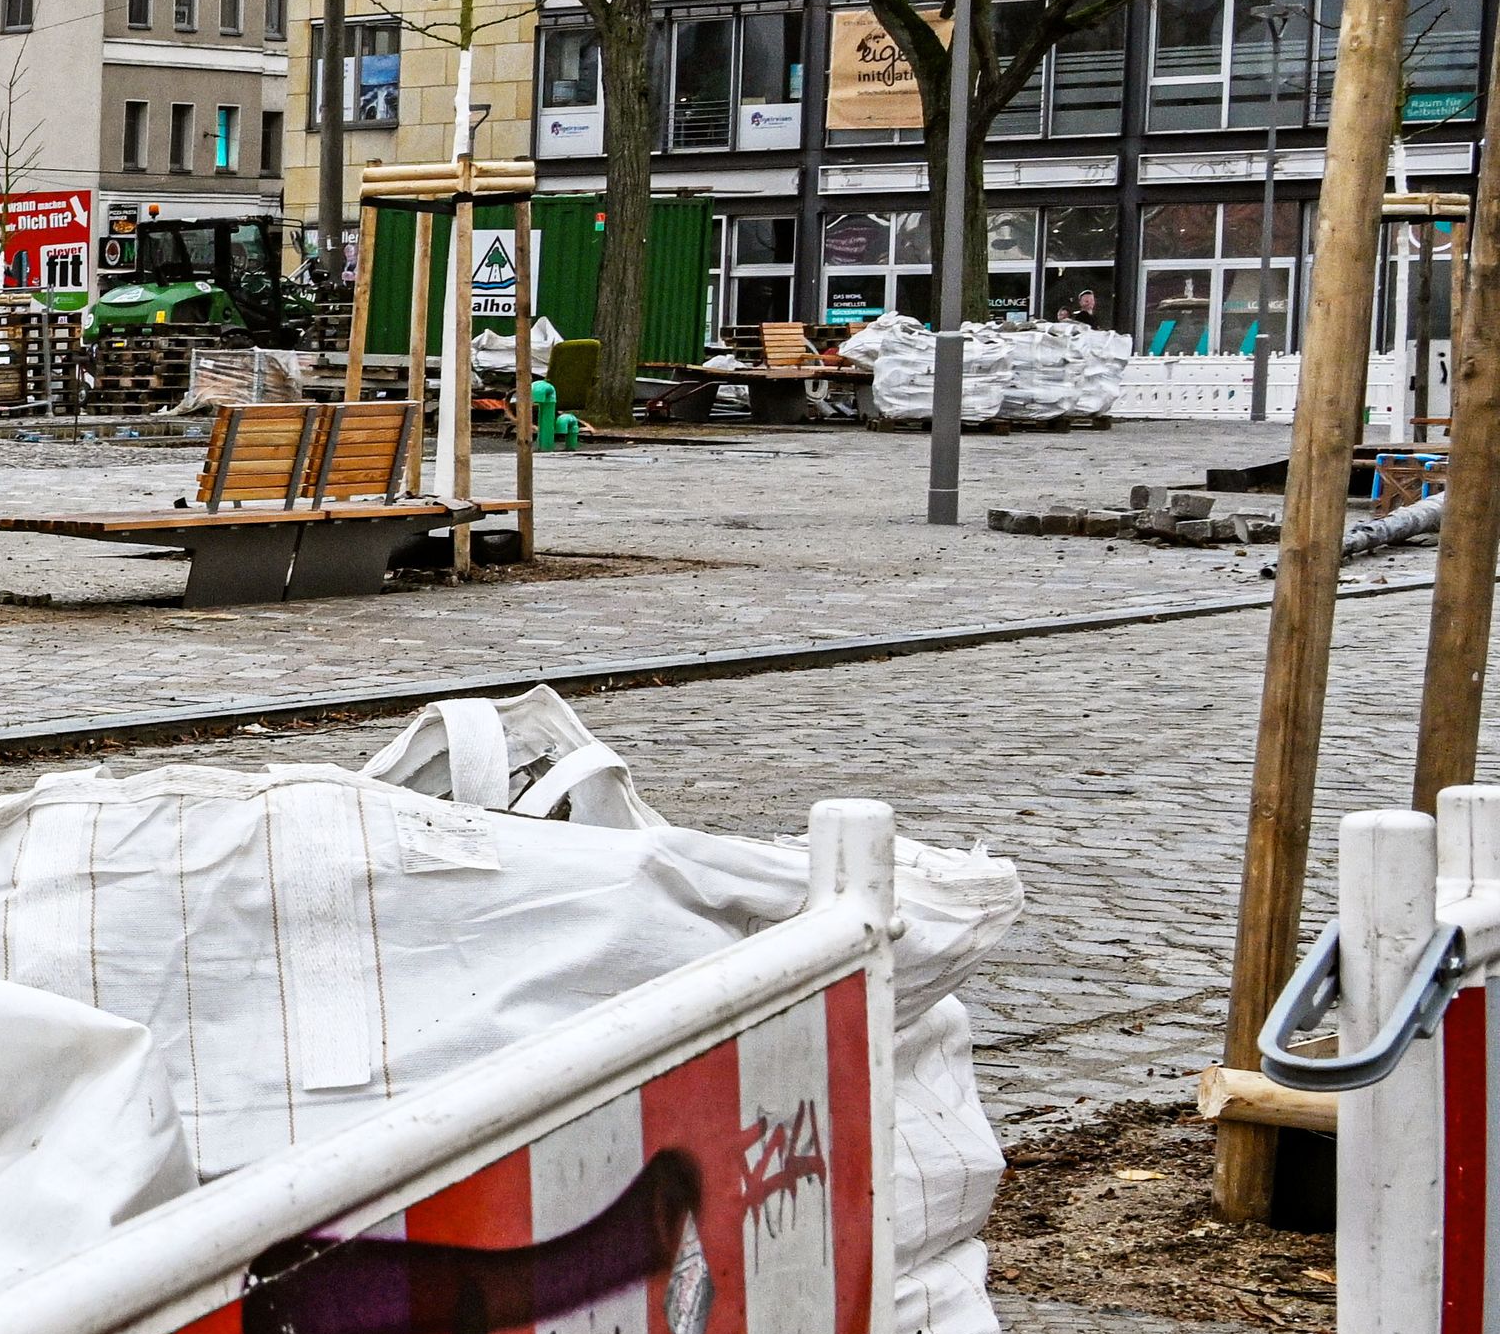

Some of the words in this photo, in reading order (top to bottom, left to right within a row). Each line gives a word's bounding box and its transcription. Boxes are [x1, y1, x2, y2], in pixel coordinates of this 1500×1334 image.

[7, 200, 37, 214] wann
[17, 213, 49, 231] Dich
[49, 211, 73, 229] fit?
[46, 245, 84, 258] clever
[46, 254, 83, 288] fit
